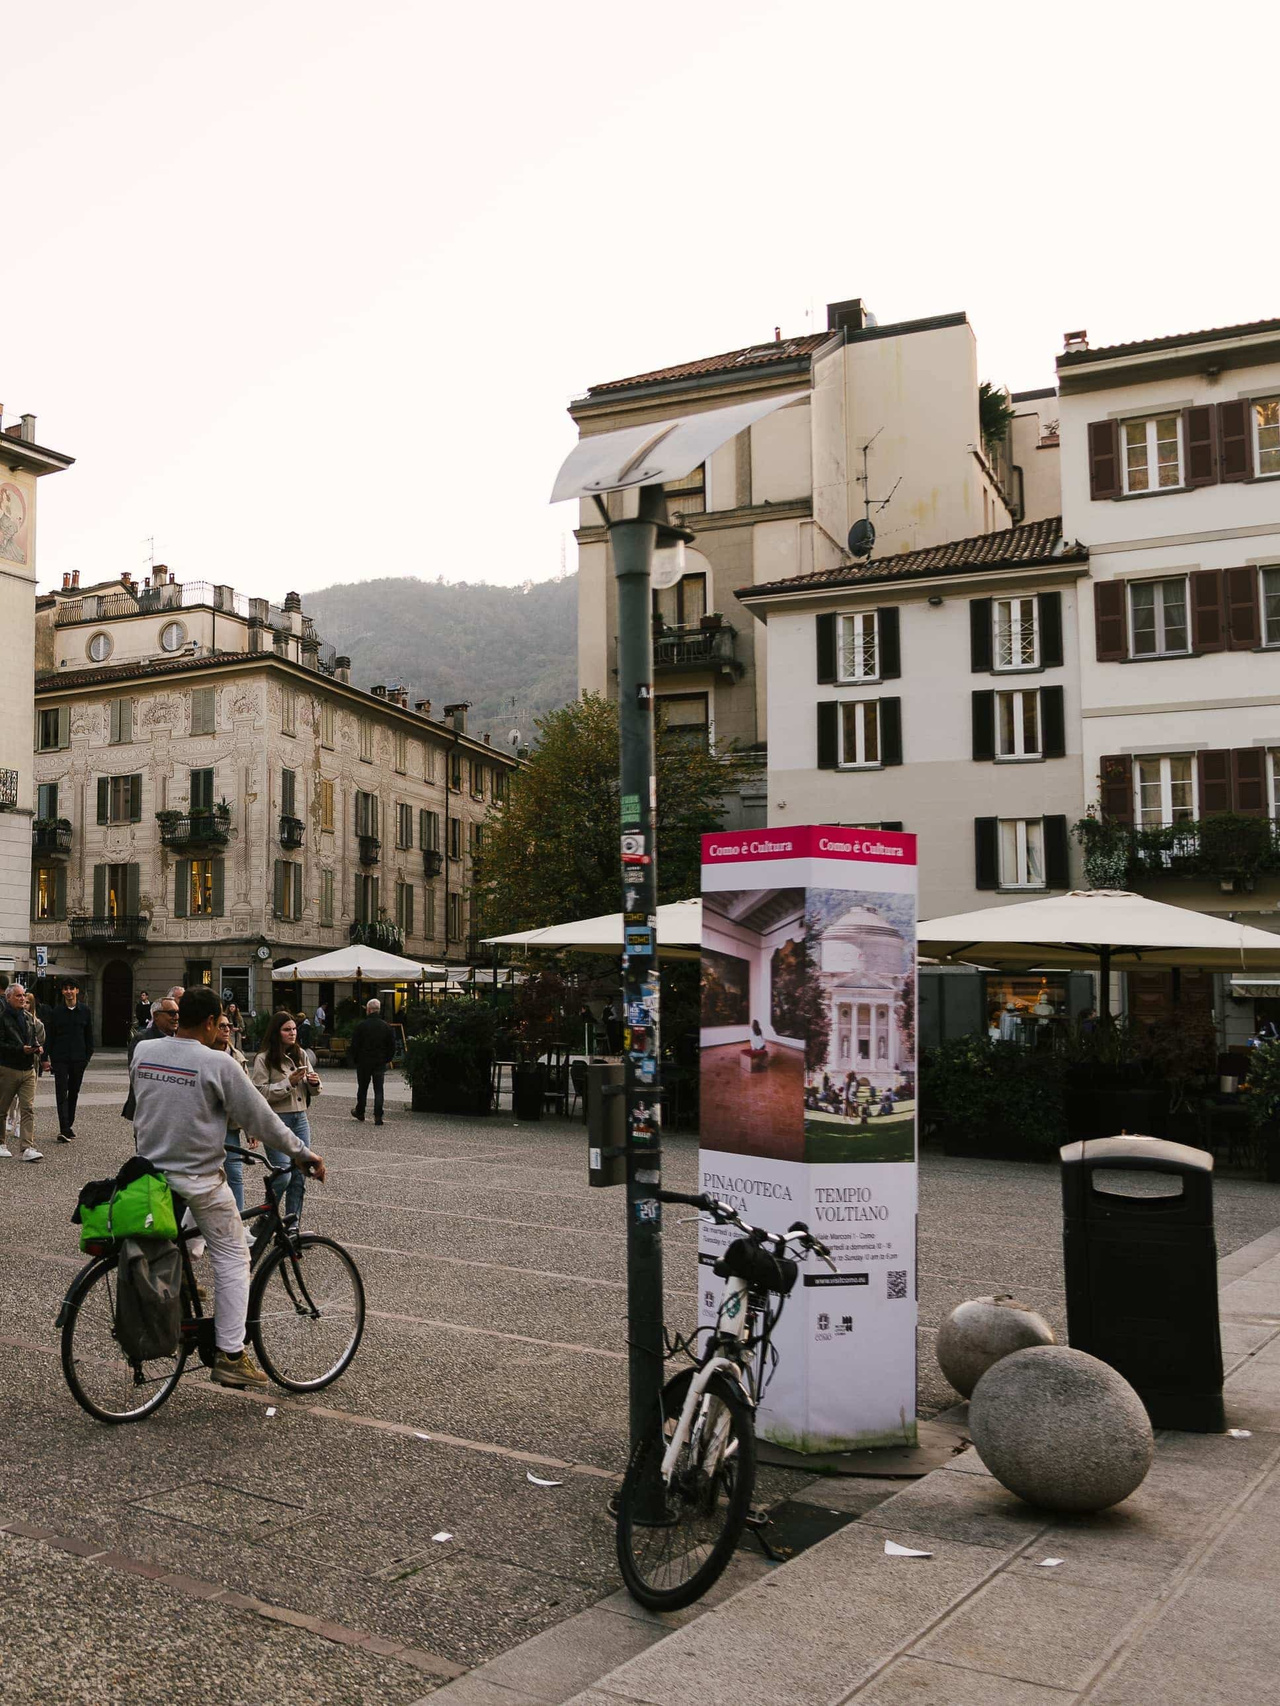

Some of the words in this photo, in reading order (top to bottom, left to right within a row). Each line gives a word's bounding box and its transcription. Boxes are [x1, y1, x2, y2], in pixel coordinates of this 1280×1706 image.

[709, 845, 740, 856] Como
[741, 842, 748, 854] è
[750, 840, 793, 854] Cultura
[819, 838, 852, 852] Como
[853, 840, 861, 853] è
[862, 841, 904, 857] Cultura
[138, 1071, 196, 1087] BELLUSCHI
[703, 1172, 793, 1201] PINACOTECA
[815, 1187, 871, 1203] TEMPIO
[705, 1190, 748, 1212] IVICA
[815, 1205, 889, 1222] VOLTIANO
